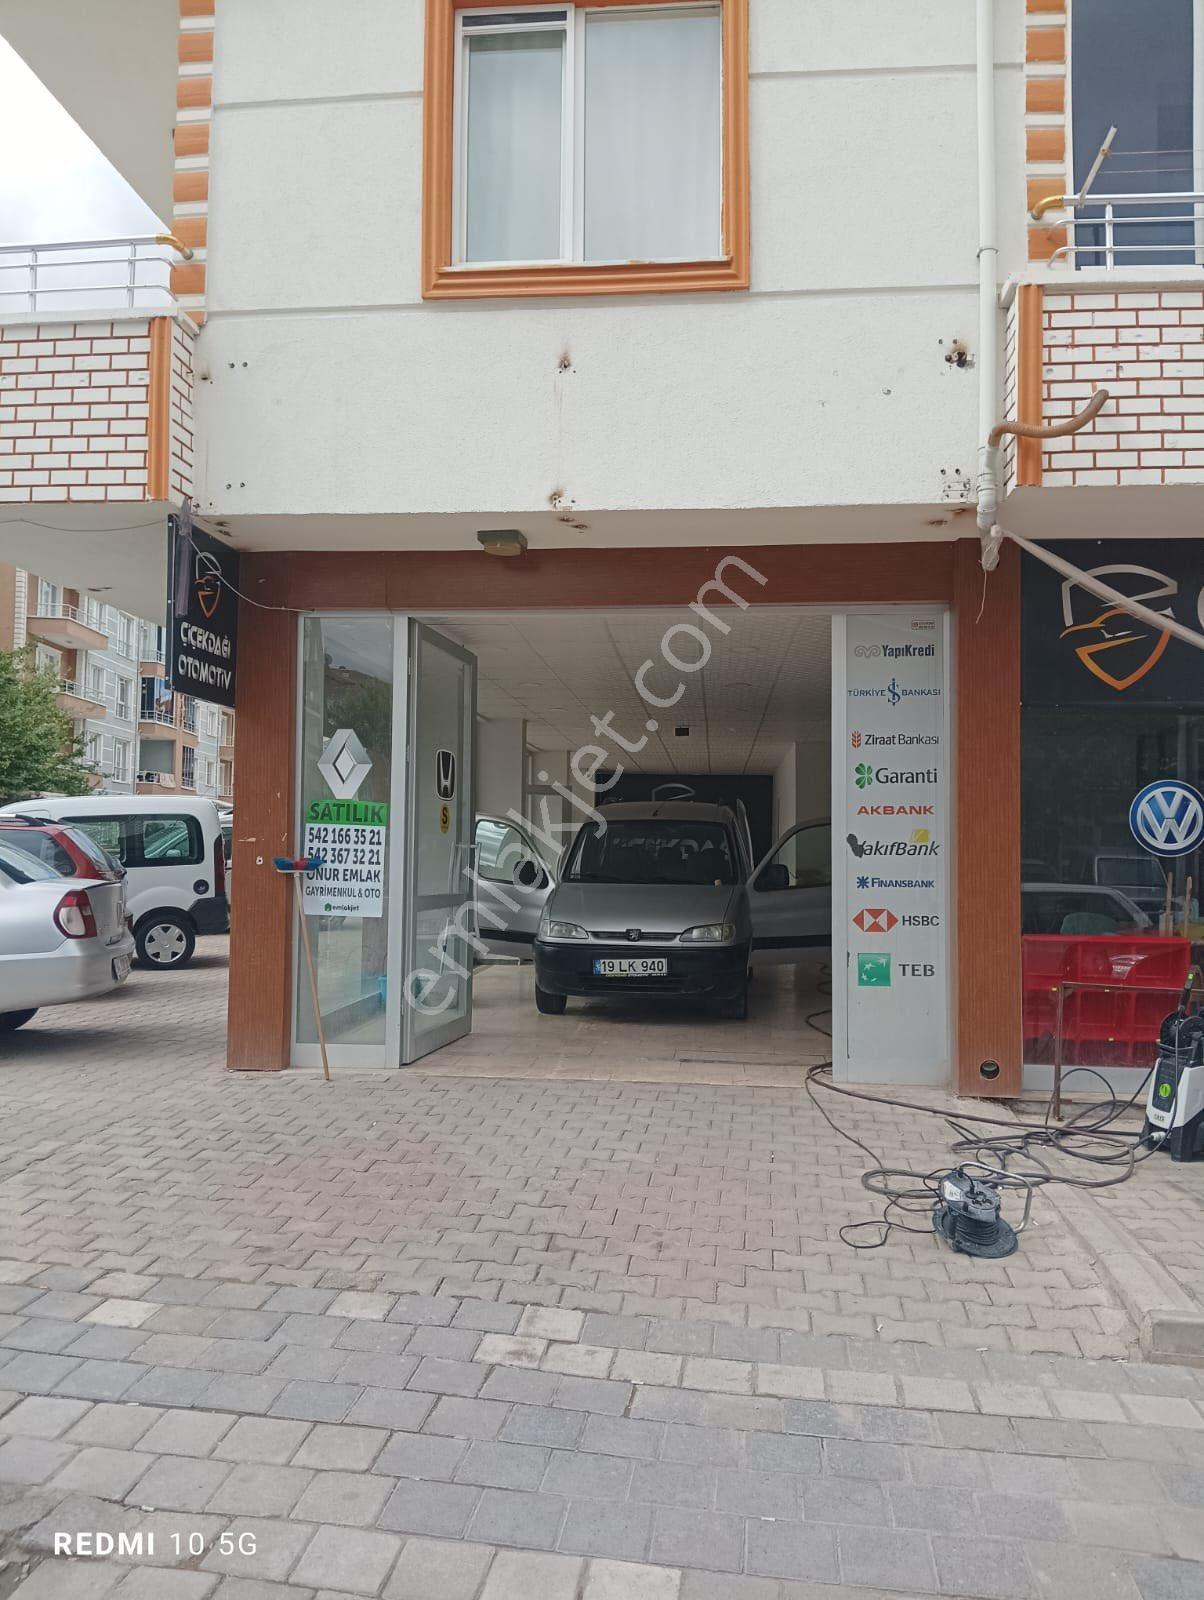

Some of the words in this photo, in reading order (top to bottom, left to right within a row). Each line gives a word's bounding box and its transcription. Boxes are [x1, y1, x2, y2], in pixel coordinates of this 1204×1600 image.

[180, 621, 231, 659] ÇİÇEKDAĞI
[882, 643, 935, 659] YapıKredi
[178, 654, 232, 691] OTOMOTİV
[847, 687, 886, 697] TÜRKİYE
[901, 688, 941, 696] BANKASI
[864, 734, 896, 745] Ziraat
[898, 733, 940, 745] Bankası
[875, 767, 938, 784] Garanti
[310, 802, 383, 823] SATILIK
[856, 805, 935, 815] AKBANK
[308, 827, 329, 844] 542
[331, 828, 351, 844] 166
[353, 829, 367, 845] 35
[368, 829, 382, 846] 21
[307, 846, 328, 864] 542
[330, 848, 350, 865] 367
[352, 848, 366, 865] 32
[367, 849, 381, 866] 21
[306, 867, 340, 882] ONUR
[342, 868, 381, 883] EMLAK
[305, 884, 357, 898] GAYRİMENKUL
[357, 888, 363, 898] &
[364, 888, 381, 899] OTO
[902, 915, 940, 927] HSBC
[602, 960, 614, 972] 19
[619, 960, 636, 972] LK
[641, 960, 664, 972] 940
[898, 964, 935, 977] TEB
